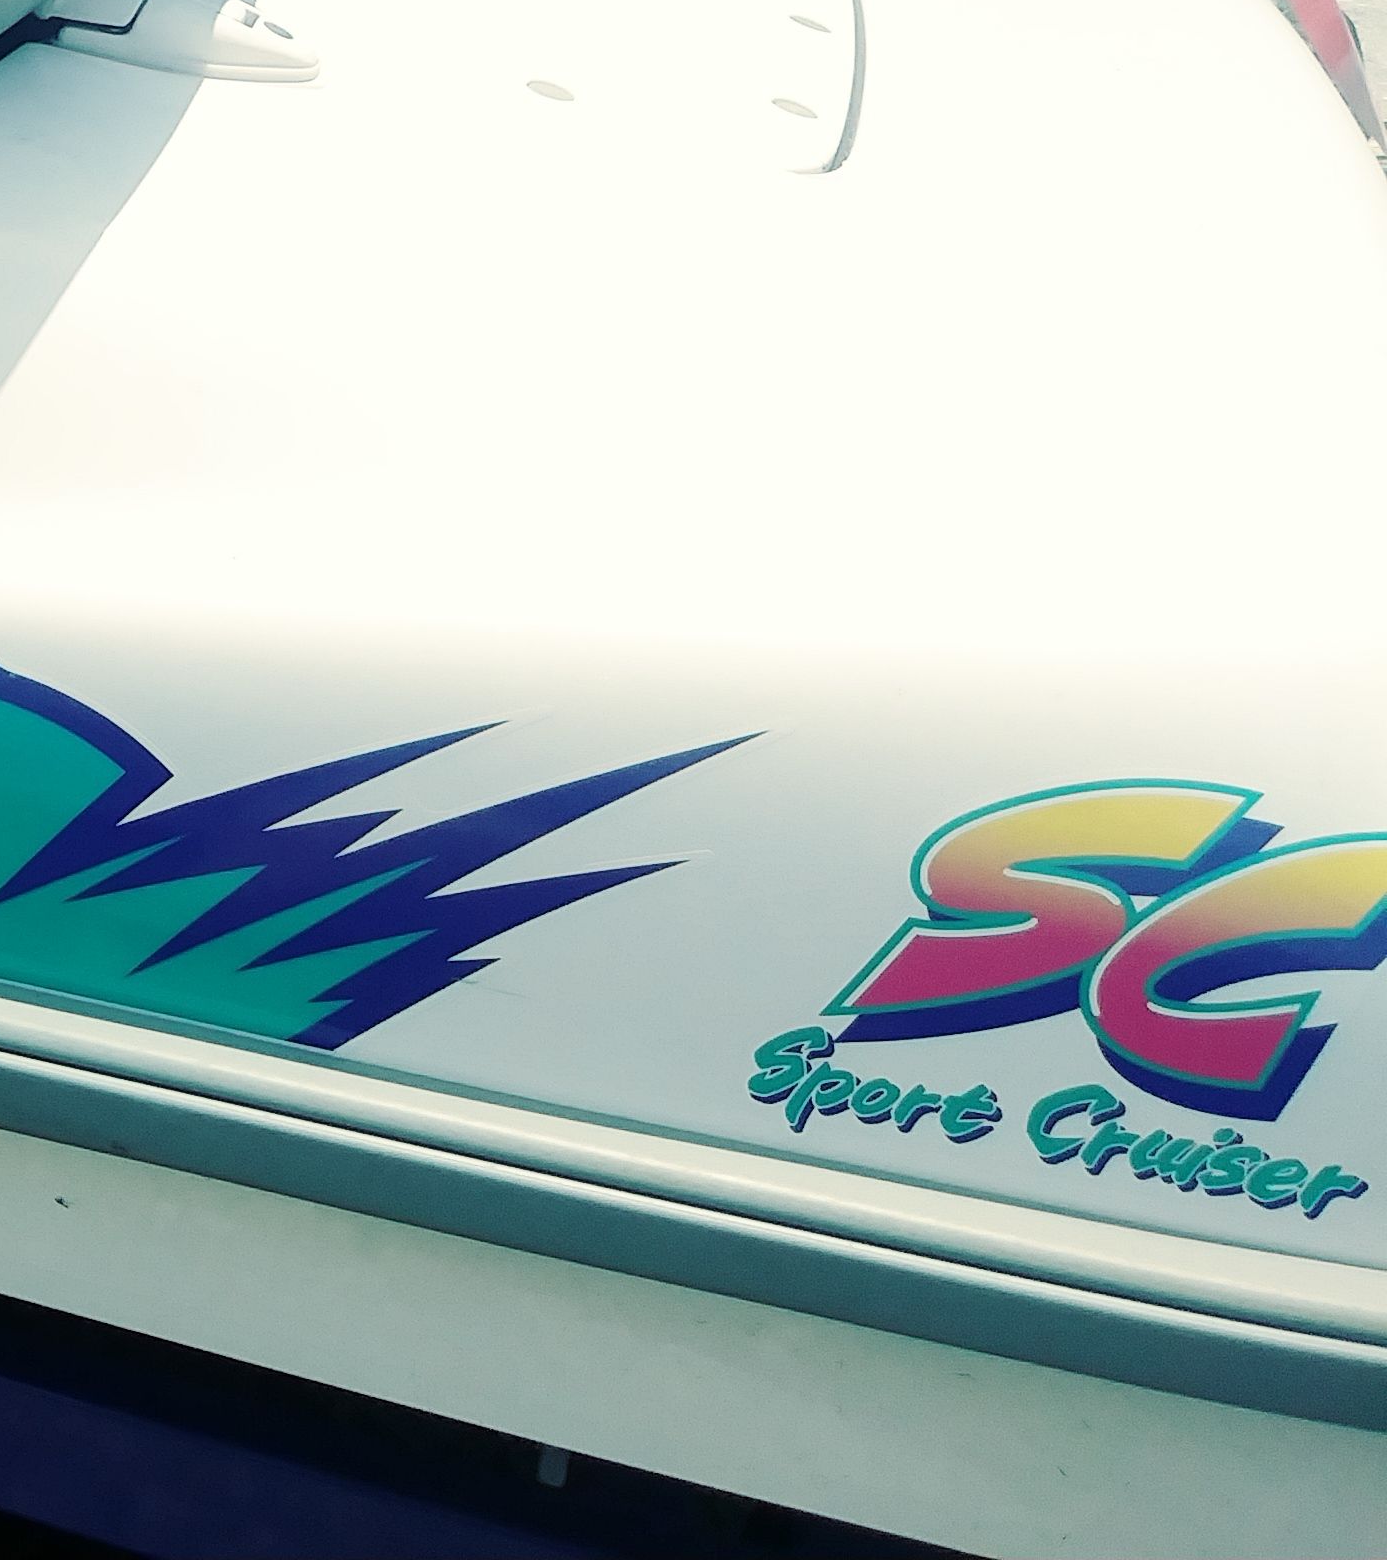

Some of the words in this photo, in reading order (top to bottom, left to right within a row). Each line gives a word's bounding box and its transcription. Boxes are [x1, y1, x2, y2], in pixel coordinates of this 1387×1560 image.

[820, 777, 1387, 1122] SC
[748, 1025, 1003, 1143] Sport
[1026, 1083, 1369, 1220] Cruiser
